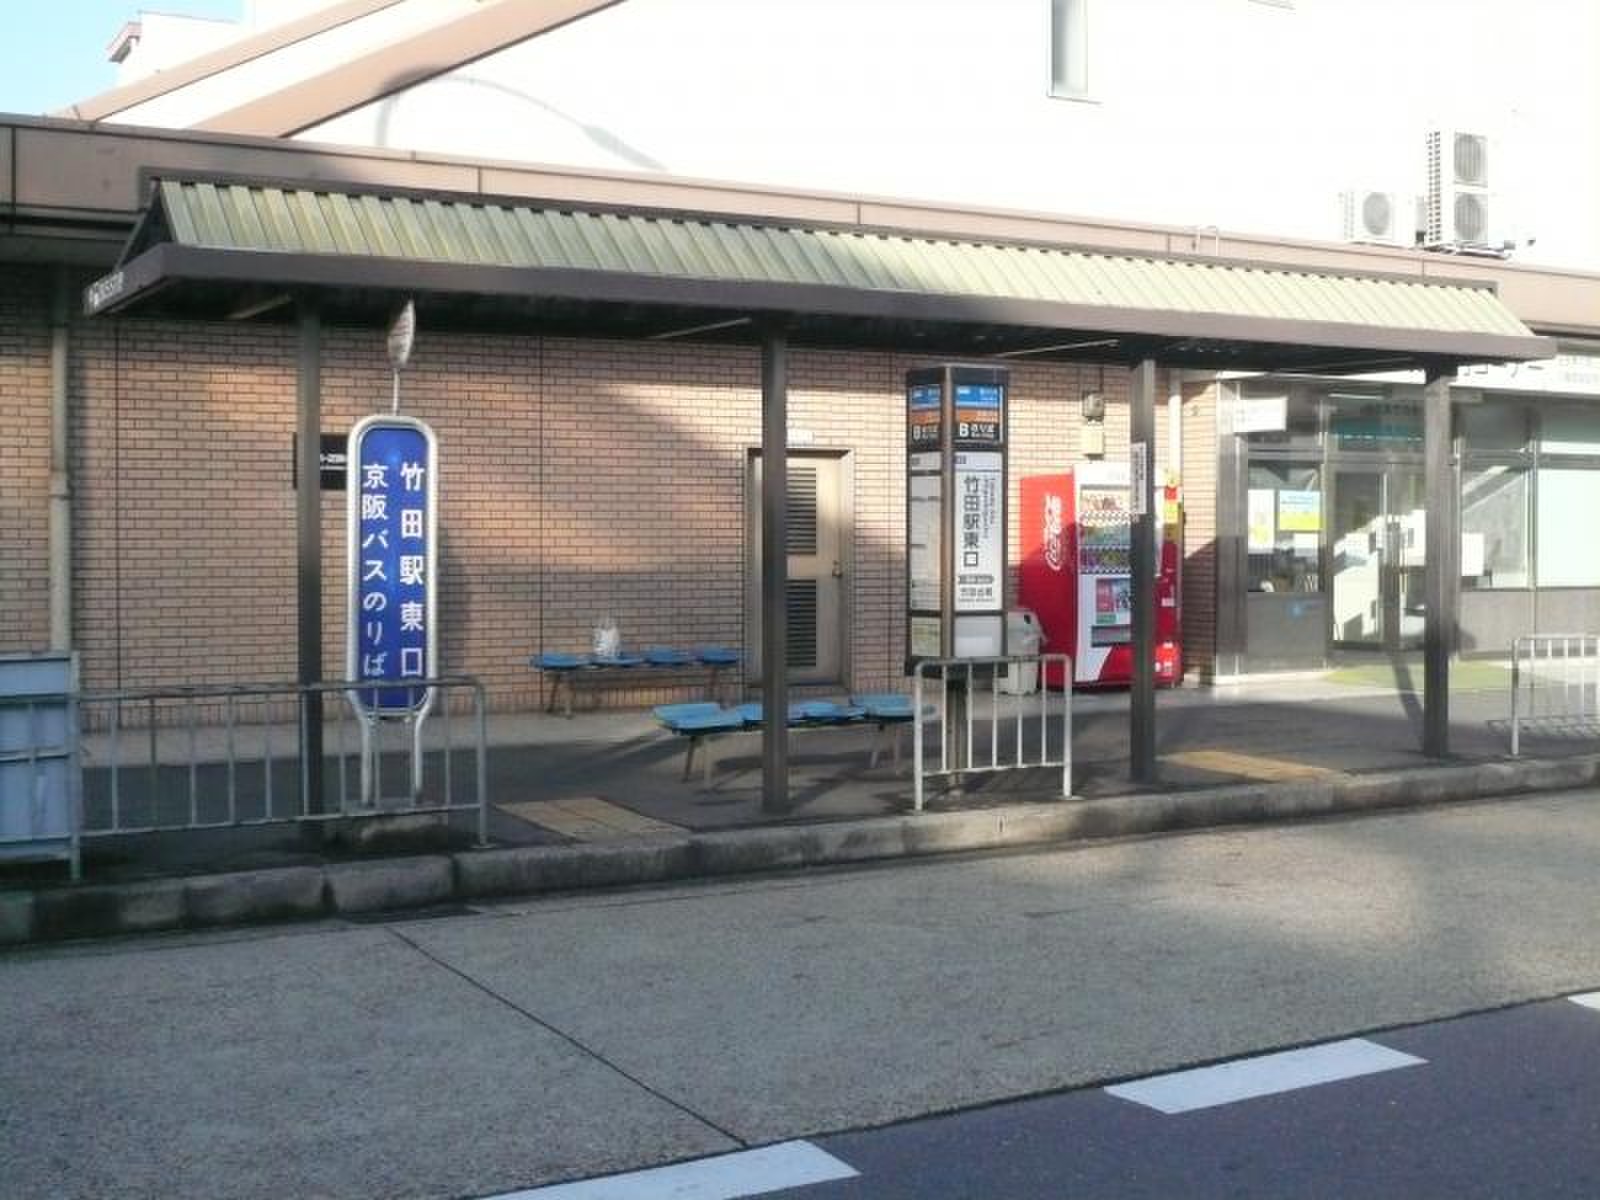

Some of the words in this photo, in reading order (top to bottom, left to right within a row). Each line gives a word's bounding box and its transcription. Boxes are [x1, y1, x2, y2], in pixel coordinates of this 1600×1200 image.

[959, 422, 970, 437] B
[362, 463, 389, 677] 京阪バスのりば
[400, 461, 425, 677] 竹田駅東口
[963, 475, 980, 568] 竹田駅東口
